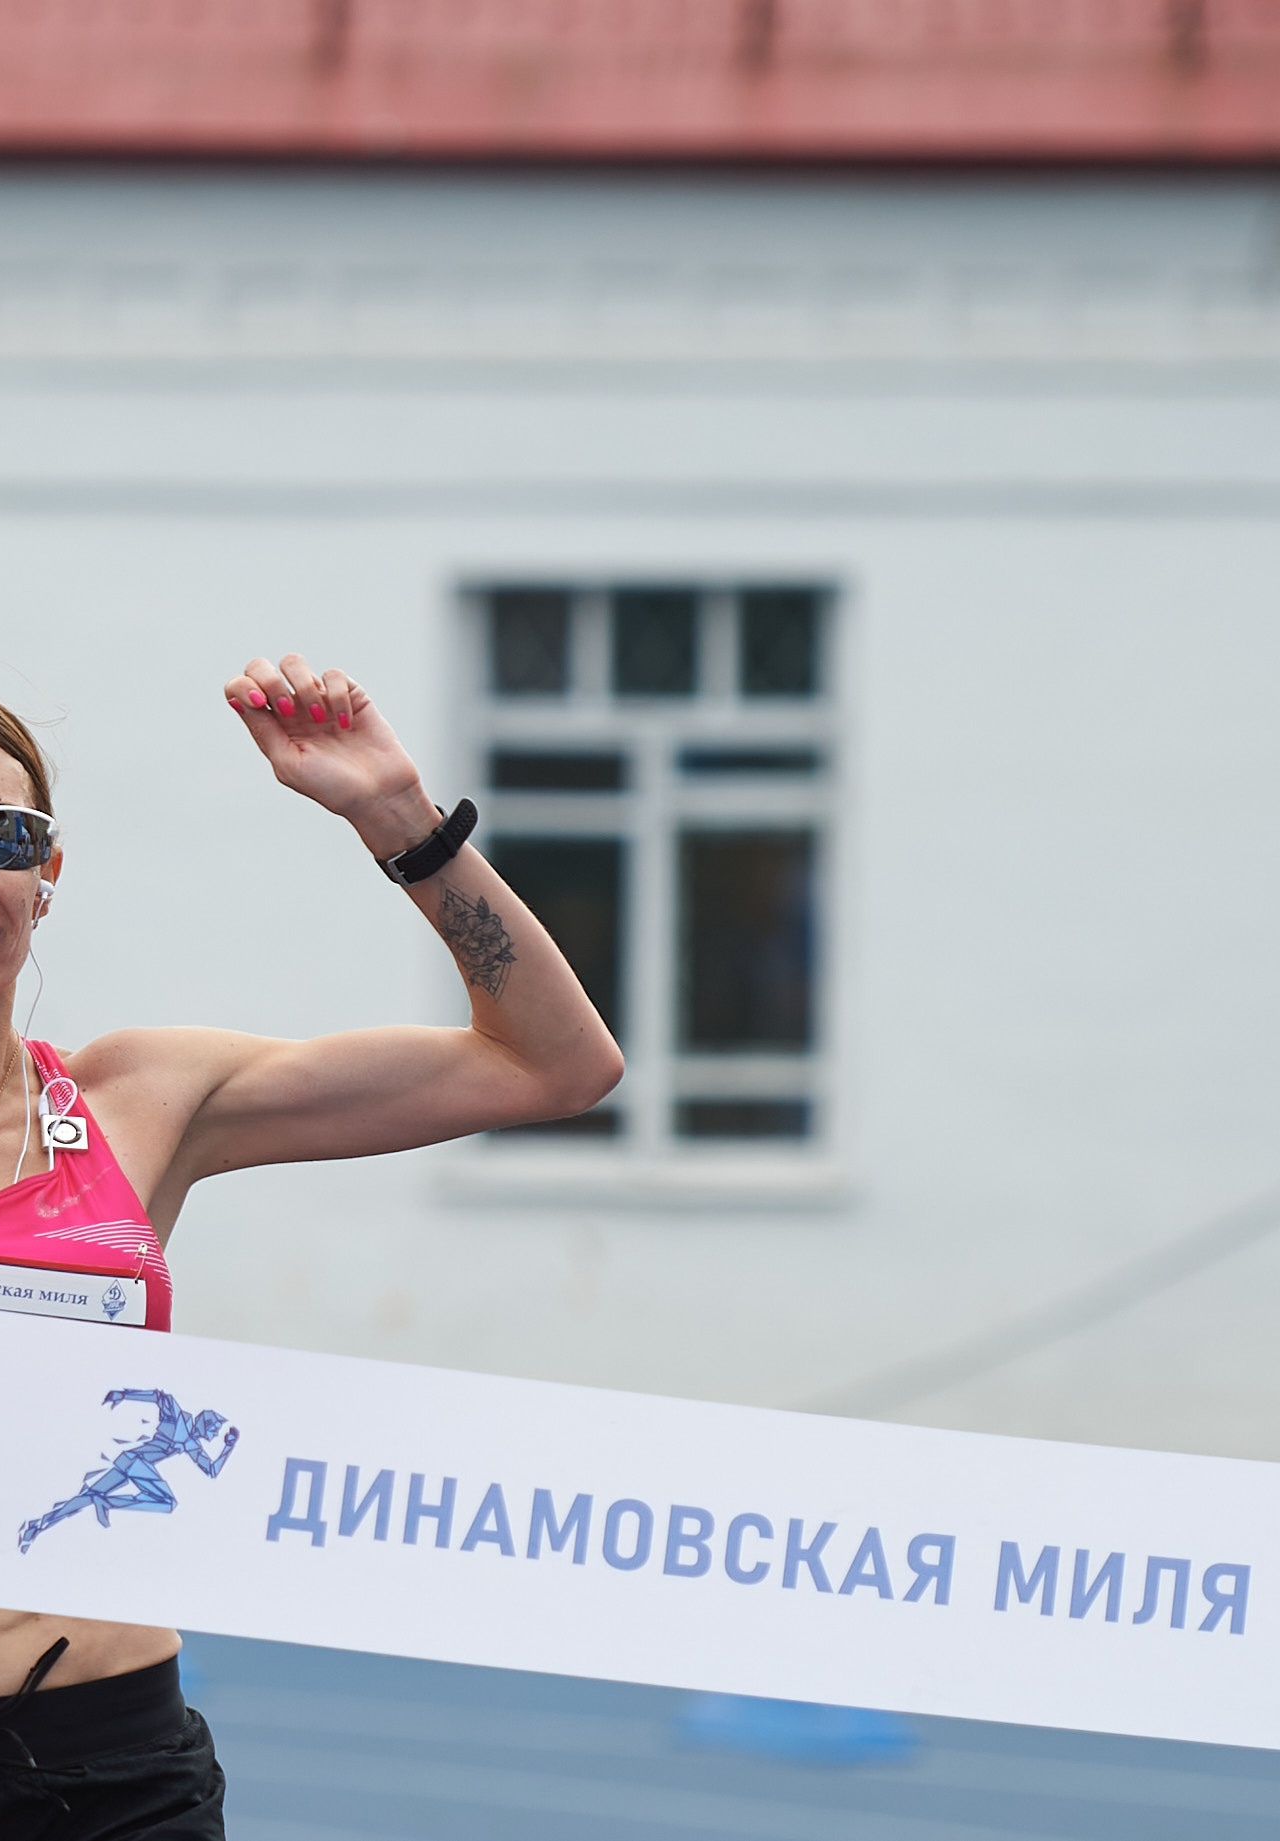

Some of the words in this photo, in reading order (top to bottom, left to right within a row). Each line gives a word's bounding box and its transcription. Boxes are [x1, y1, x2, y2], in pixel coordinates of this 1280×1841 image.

[39, 1289, 89, 1306] миля
[265, 1456, 957, 1606] ДИНАМОВСКАЯ
[993, 1540, 1252, 1636] МИЛЯ
